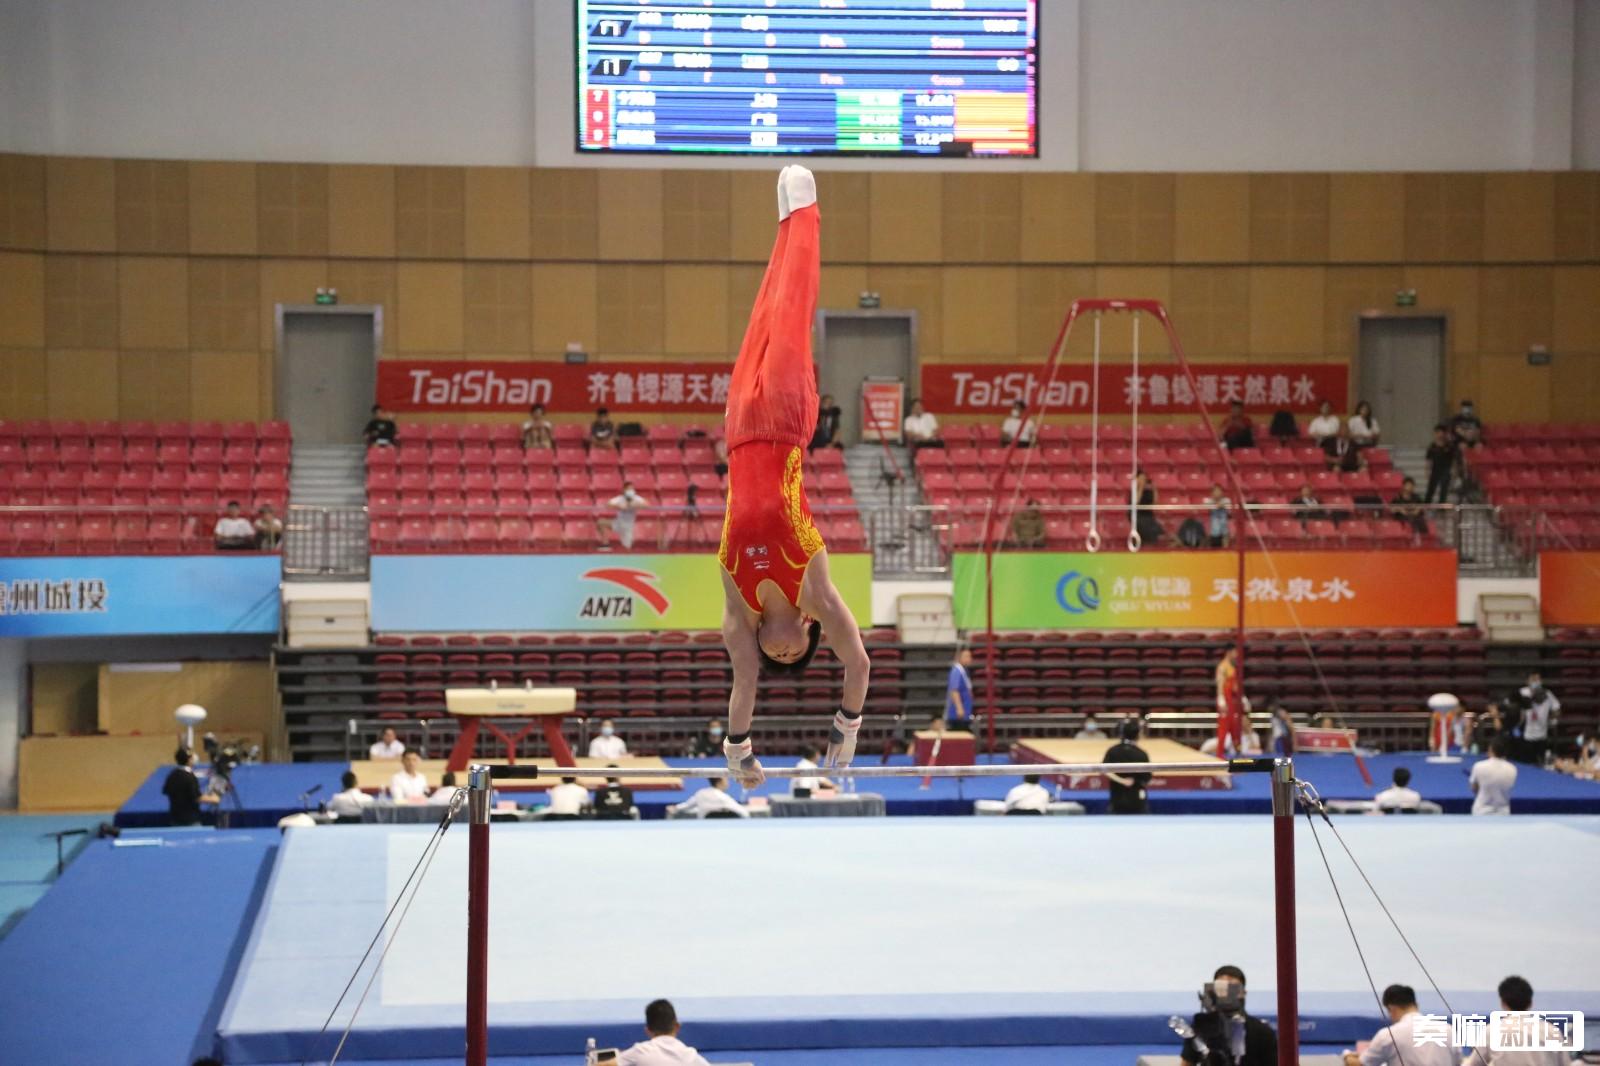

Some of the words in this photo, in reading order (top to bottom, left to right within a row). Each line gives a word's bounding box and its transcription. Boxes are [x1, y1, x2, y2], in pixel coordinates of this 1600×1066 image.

[410, 370, 551, 404] TaiShan
[952, 373, 1089, 406] TaiShan
[1208, 577, 1355, 603] 天然泉水
[580, 597, 632, 617] ANTA
